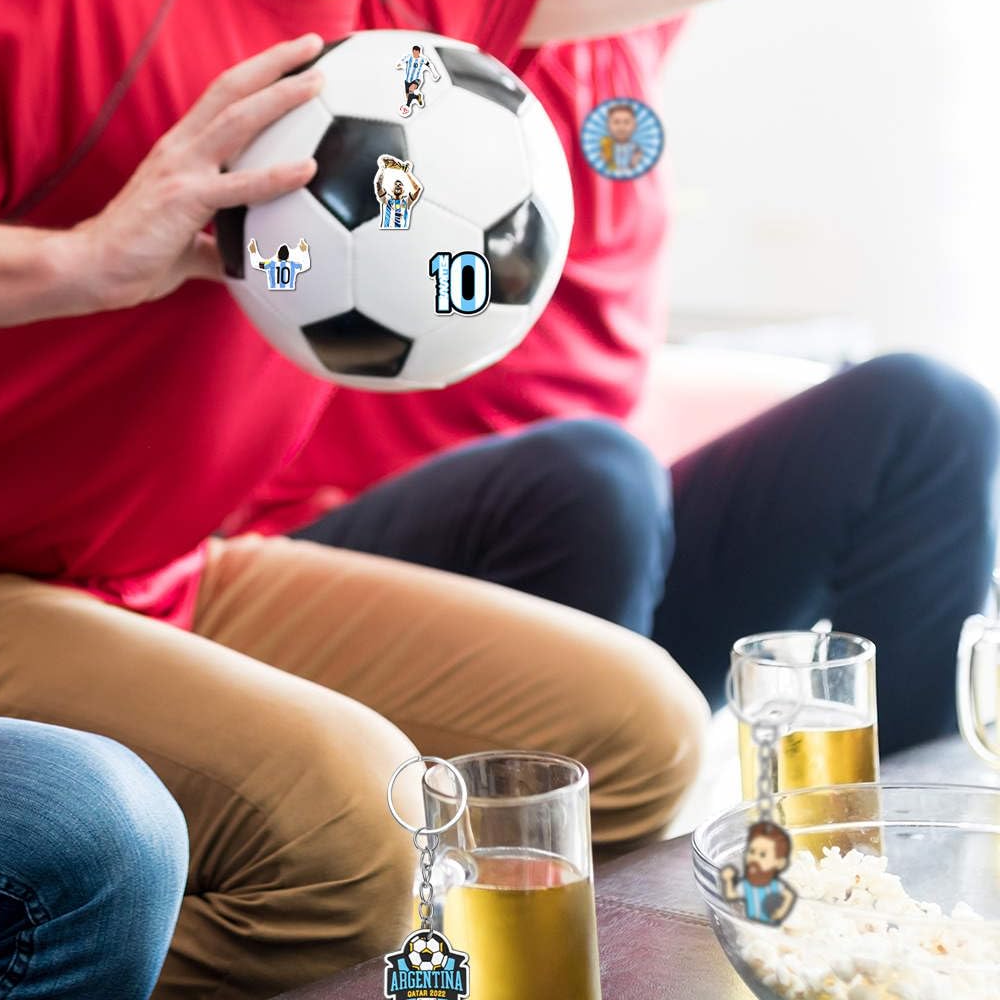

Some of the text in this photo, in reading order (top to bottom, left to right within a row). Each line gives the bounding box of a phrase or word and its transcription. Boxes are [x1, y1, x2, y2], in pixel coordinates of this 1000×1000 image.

[276, 266, 290, 284] 10
[429, 251, 490, 314] 10
[390, 970, 463, 992] ARGENTINA
[407, 990, 446, 998] QATAR 2022
